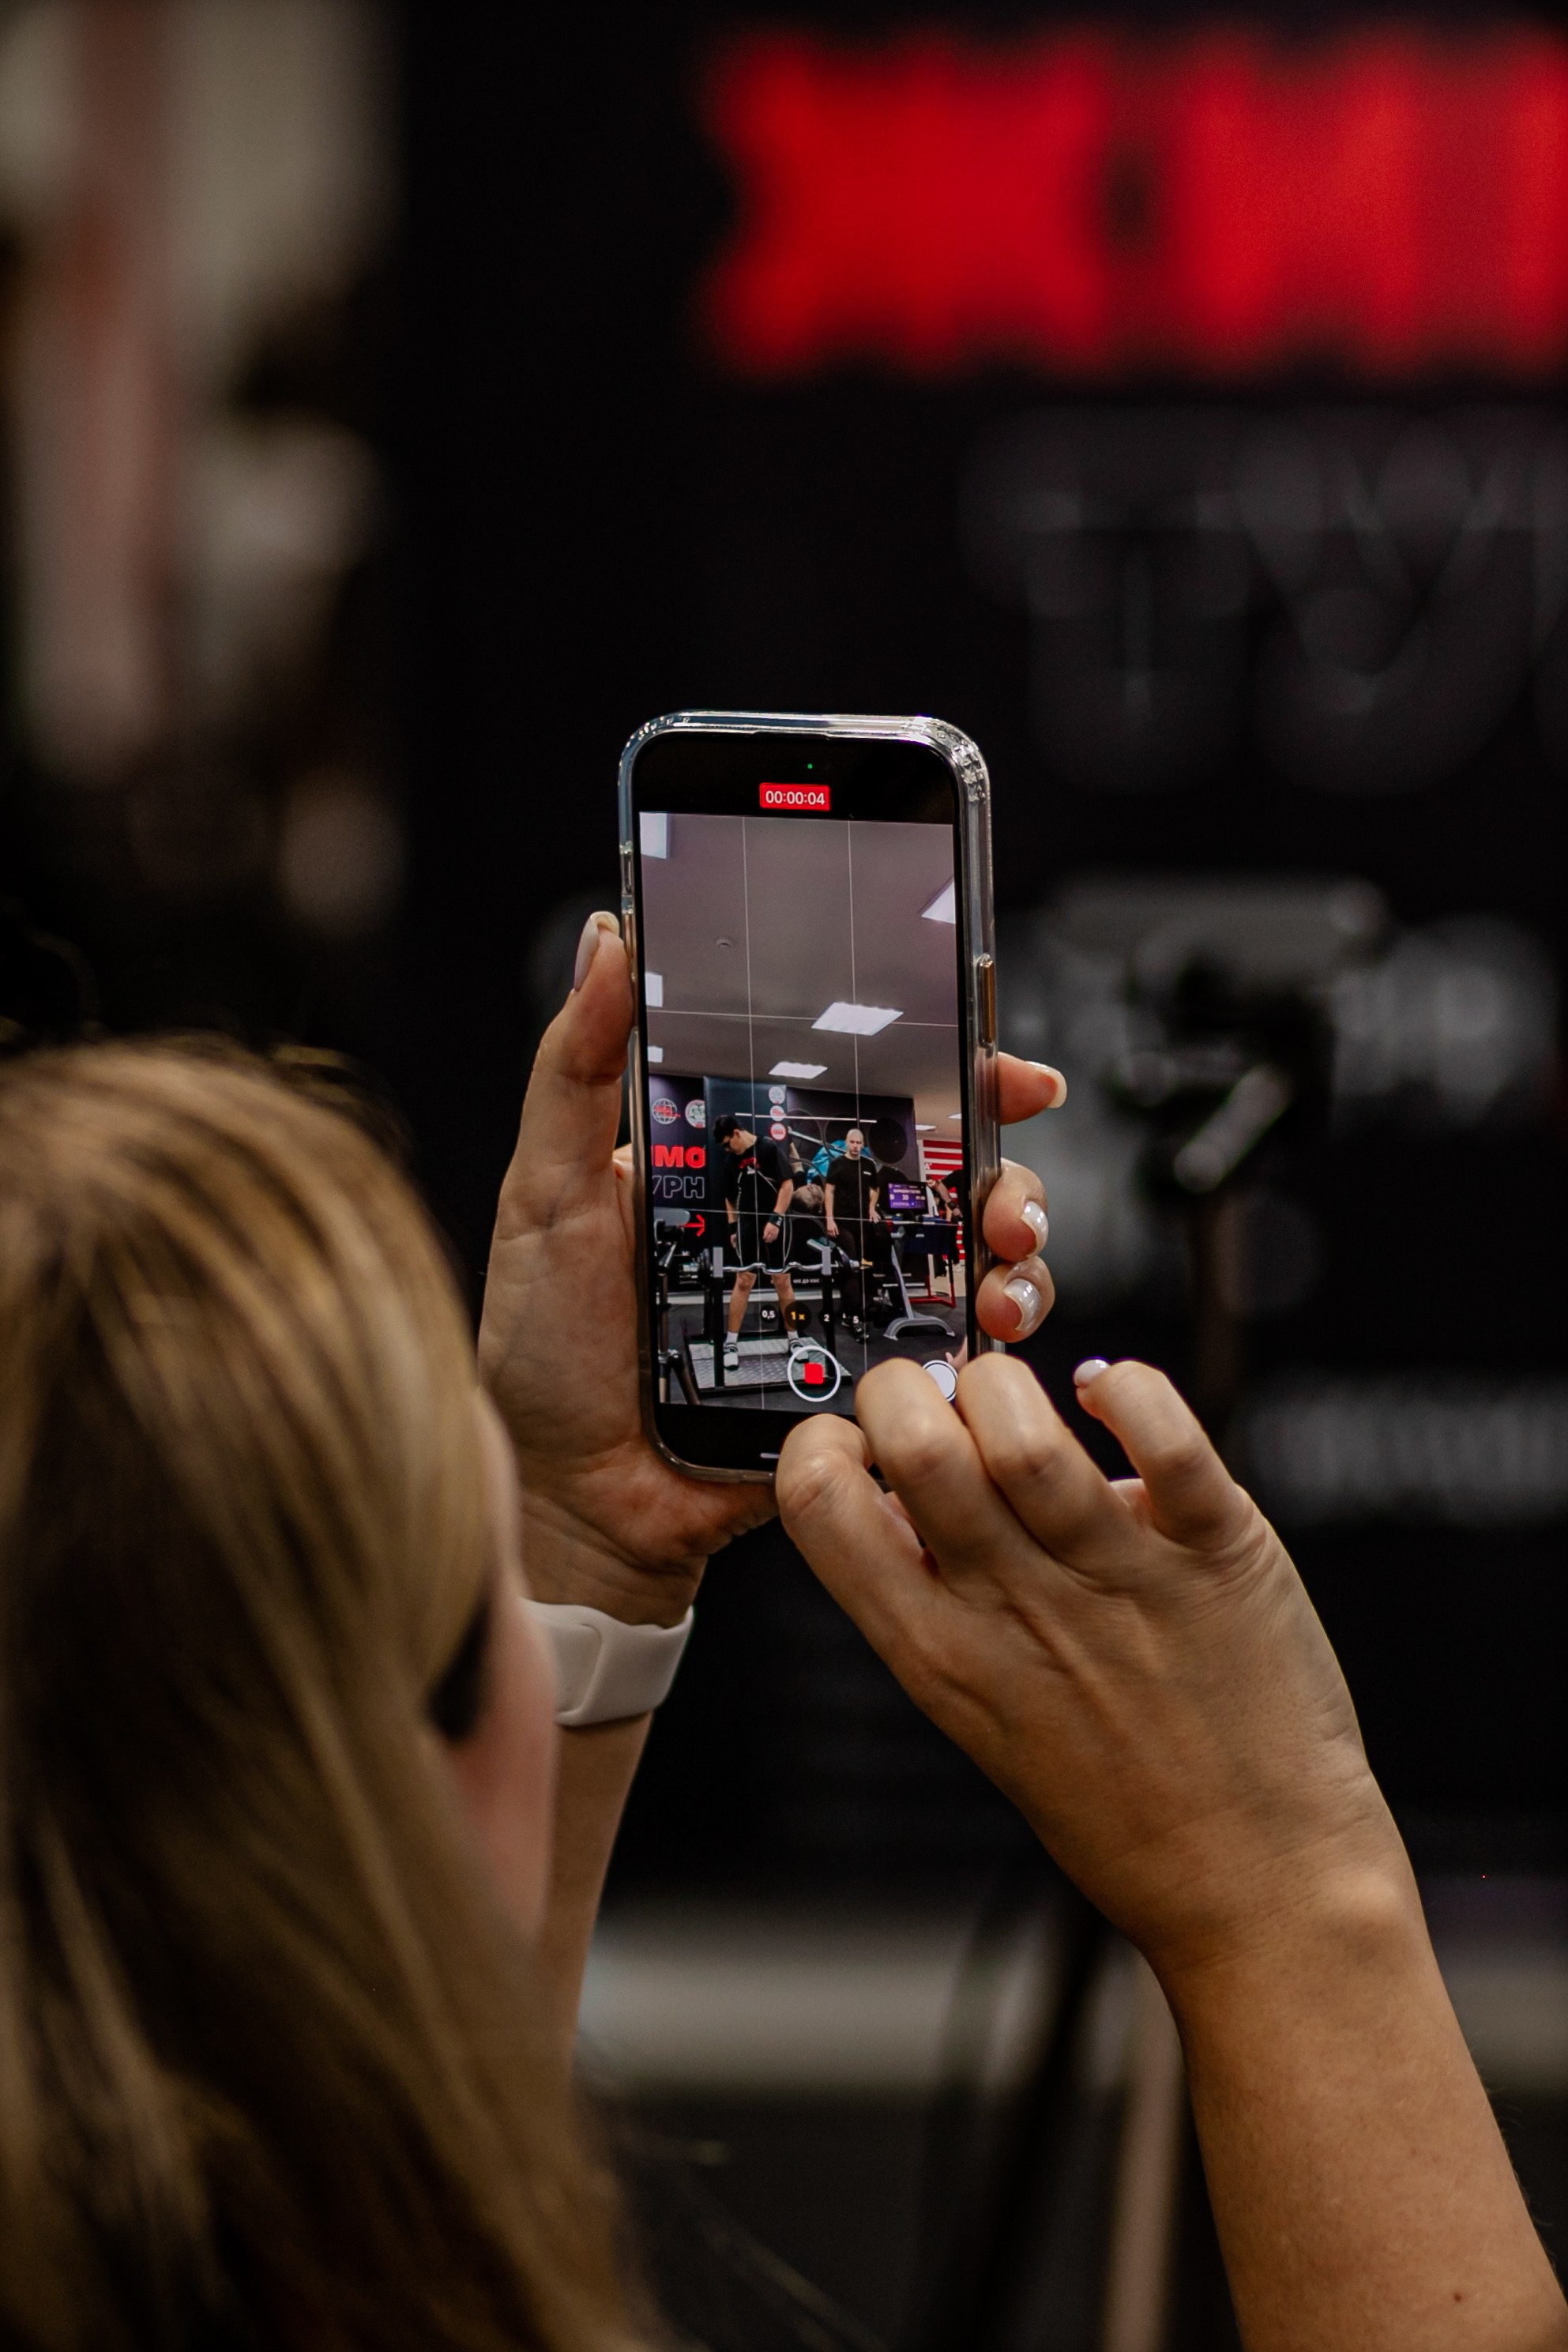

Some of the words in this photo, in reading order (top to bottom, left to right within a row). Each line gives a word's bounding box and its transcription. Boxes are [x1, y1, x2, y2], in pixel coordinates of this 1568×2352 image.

[765, 791, 825, 805] 00:00:04
[651, 1145, 705, 1168] МО
[761, 1309, 775, 1319] 0,5
